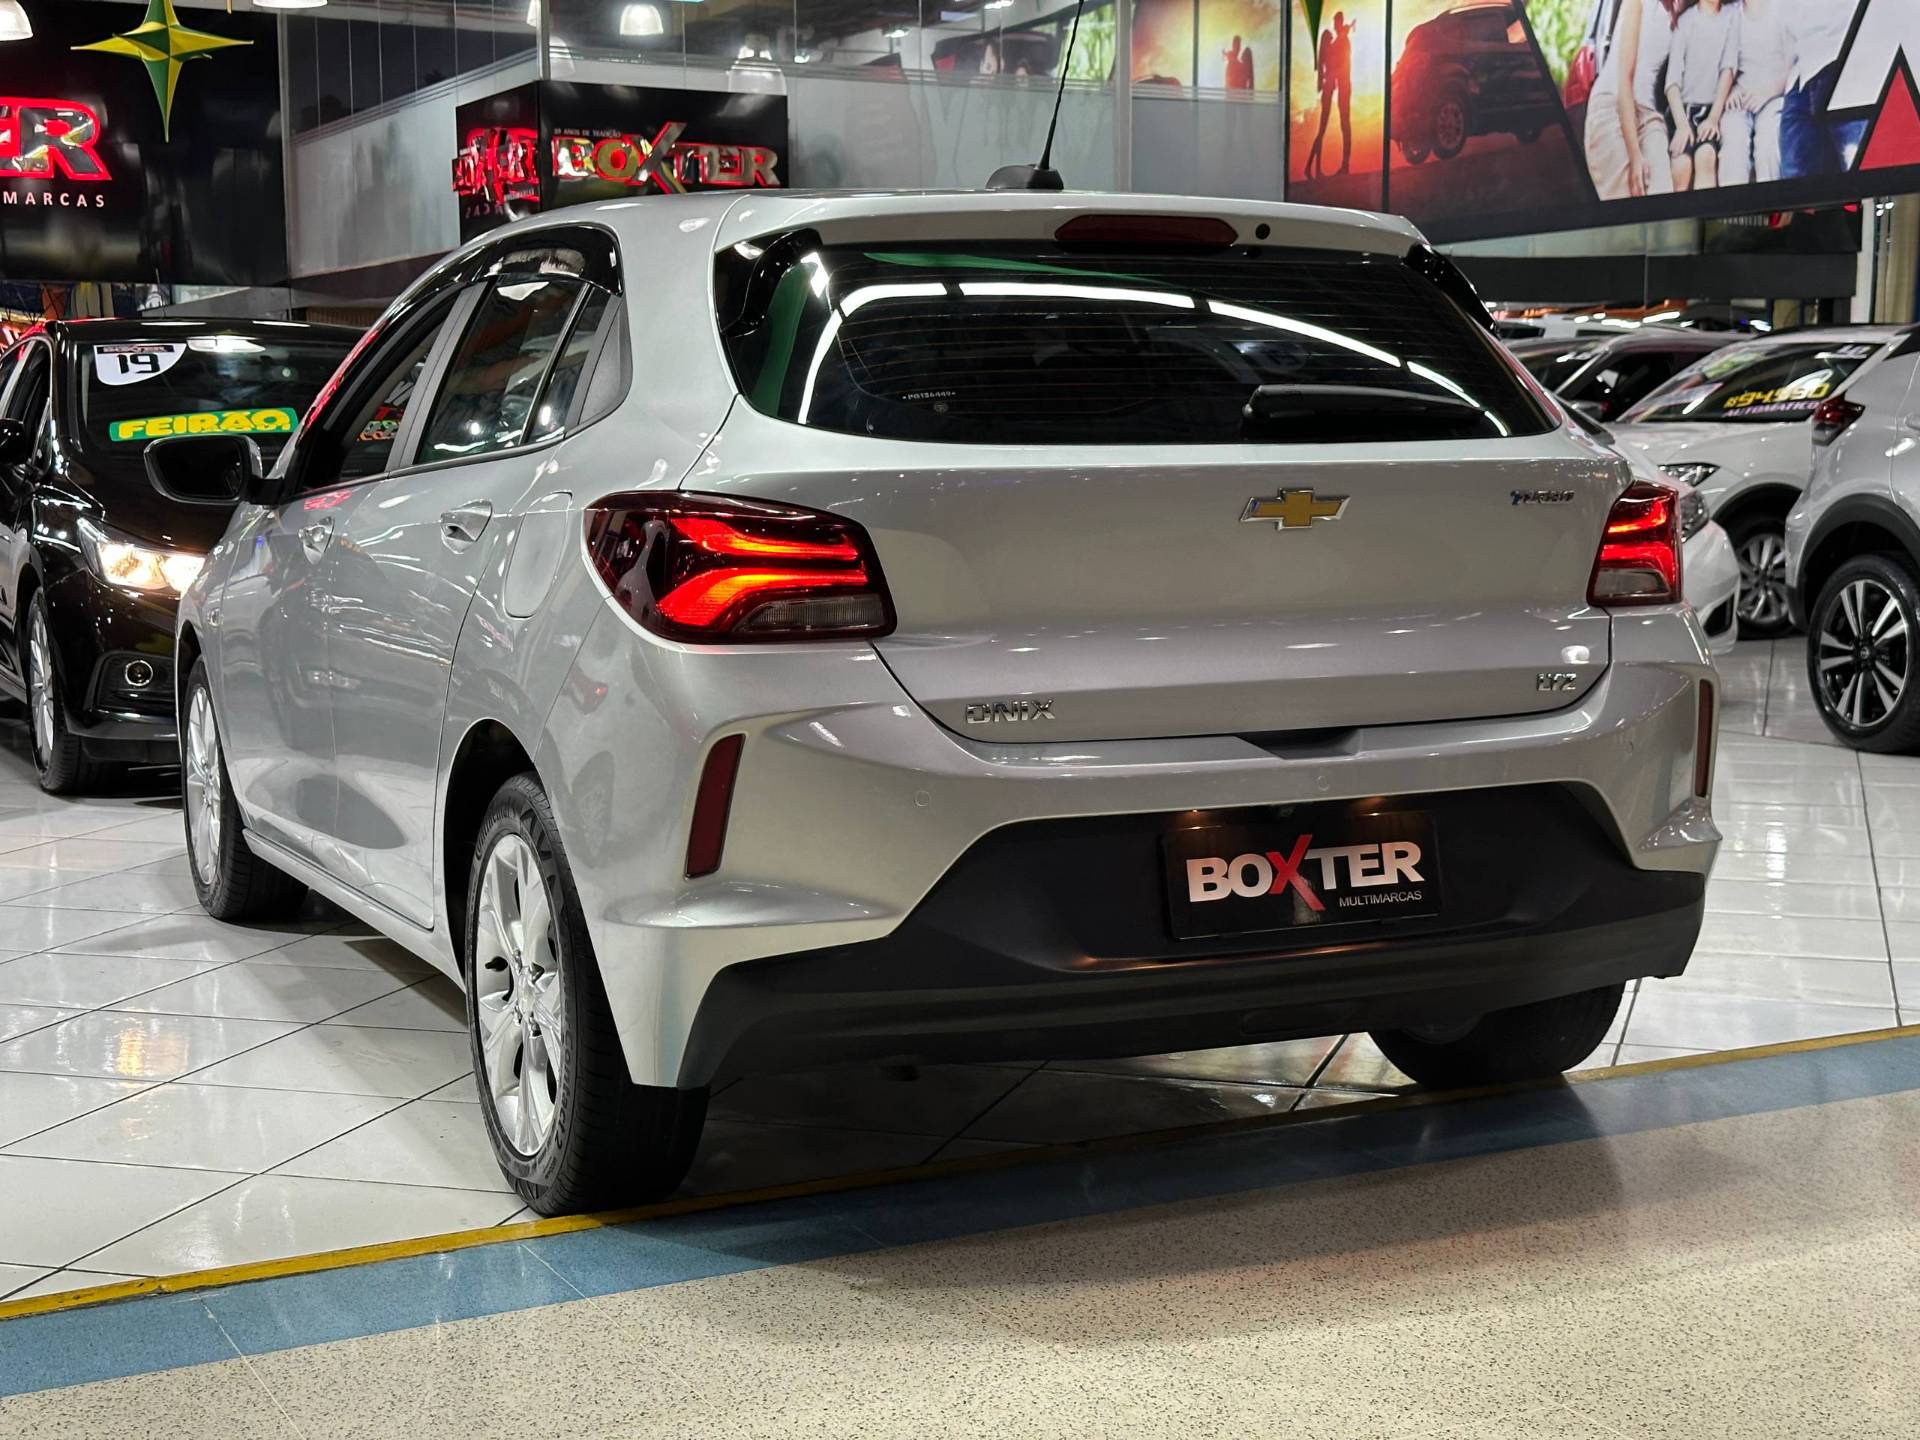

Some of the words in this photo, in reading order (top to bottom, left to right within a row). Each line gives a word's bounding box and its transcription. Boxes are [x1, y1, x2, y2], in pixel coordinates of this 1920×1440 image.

[118, 353, 160, 374] 19
[118, 409, 291, 439] FEIRÃO
[966, 699, 1056, 724] ONIX
[1186, 834, 1425, 912] BOXTER
[1338, 891, 1422, 908] MULTIMARCAS
